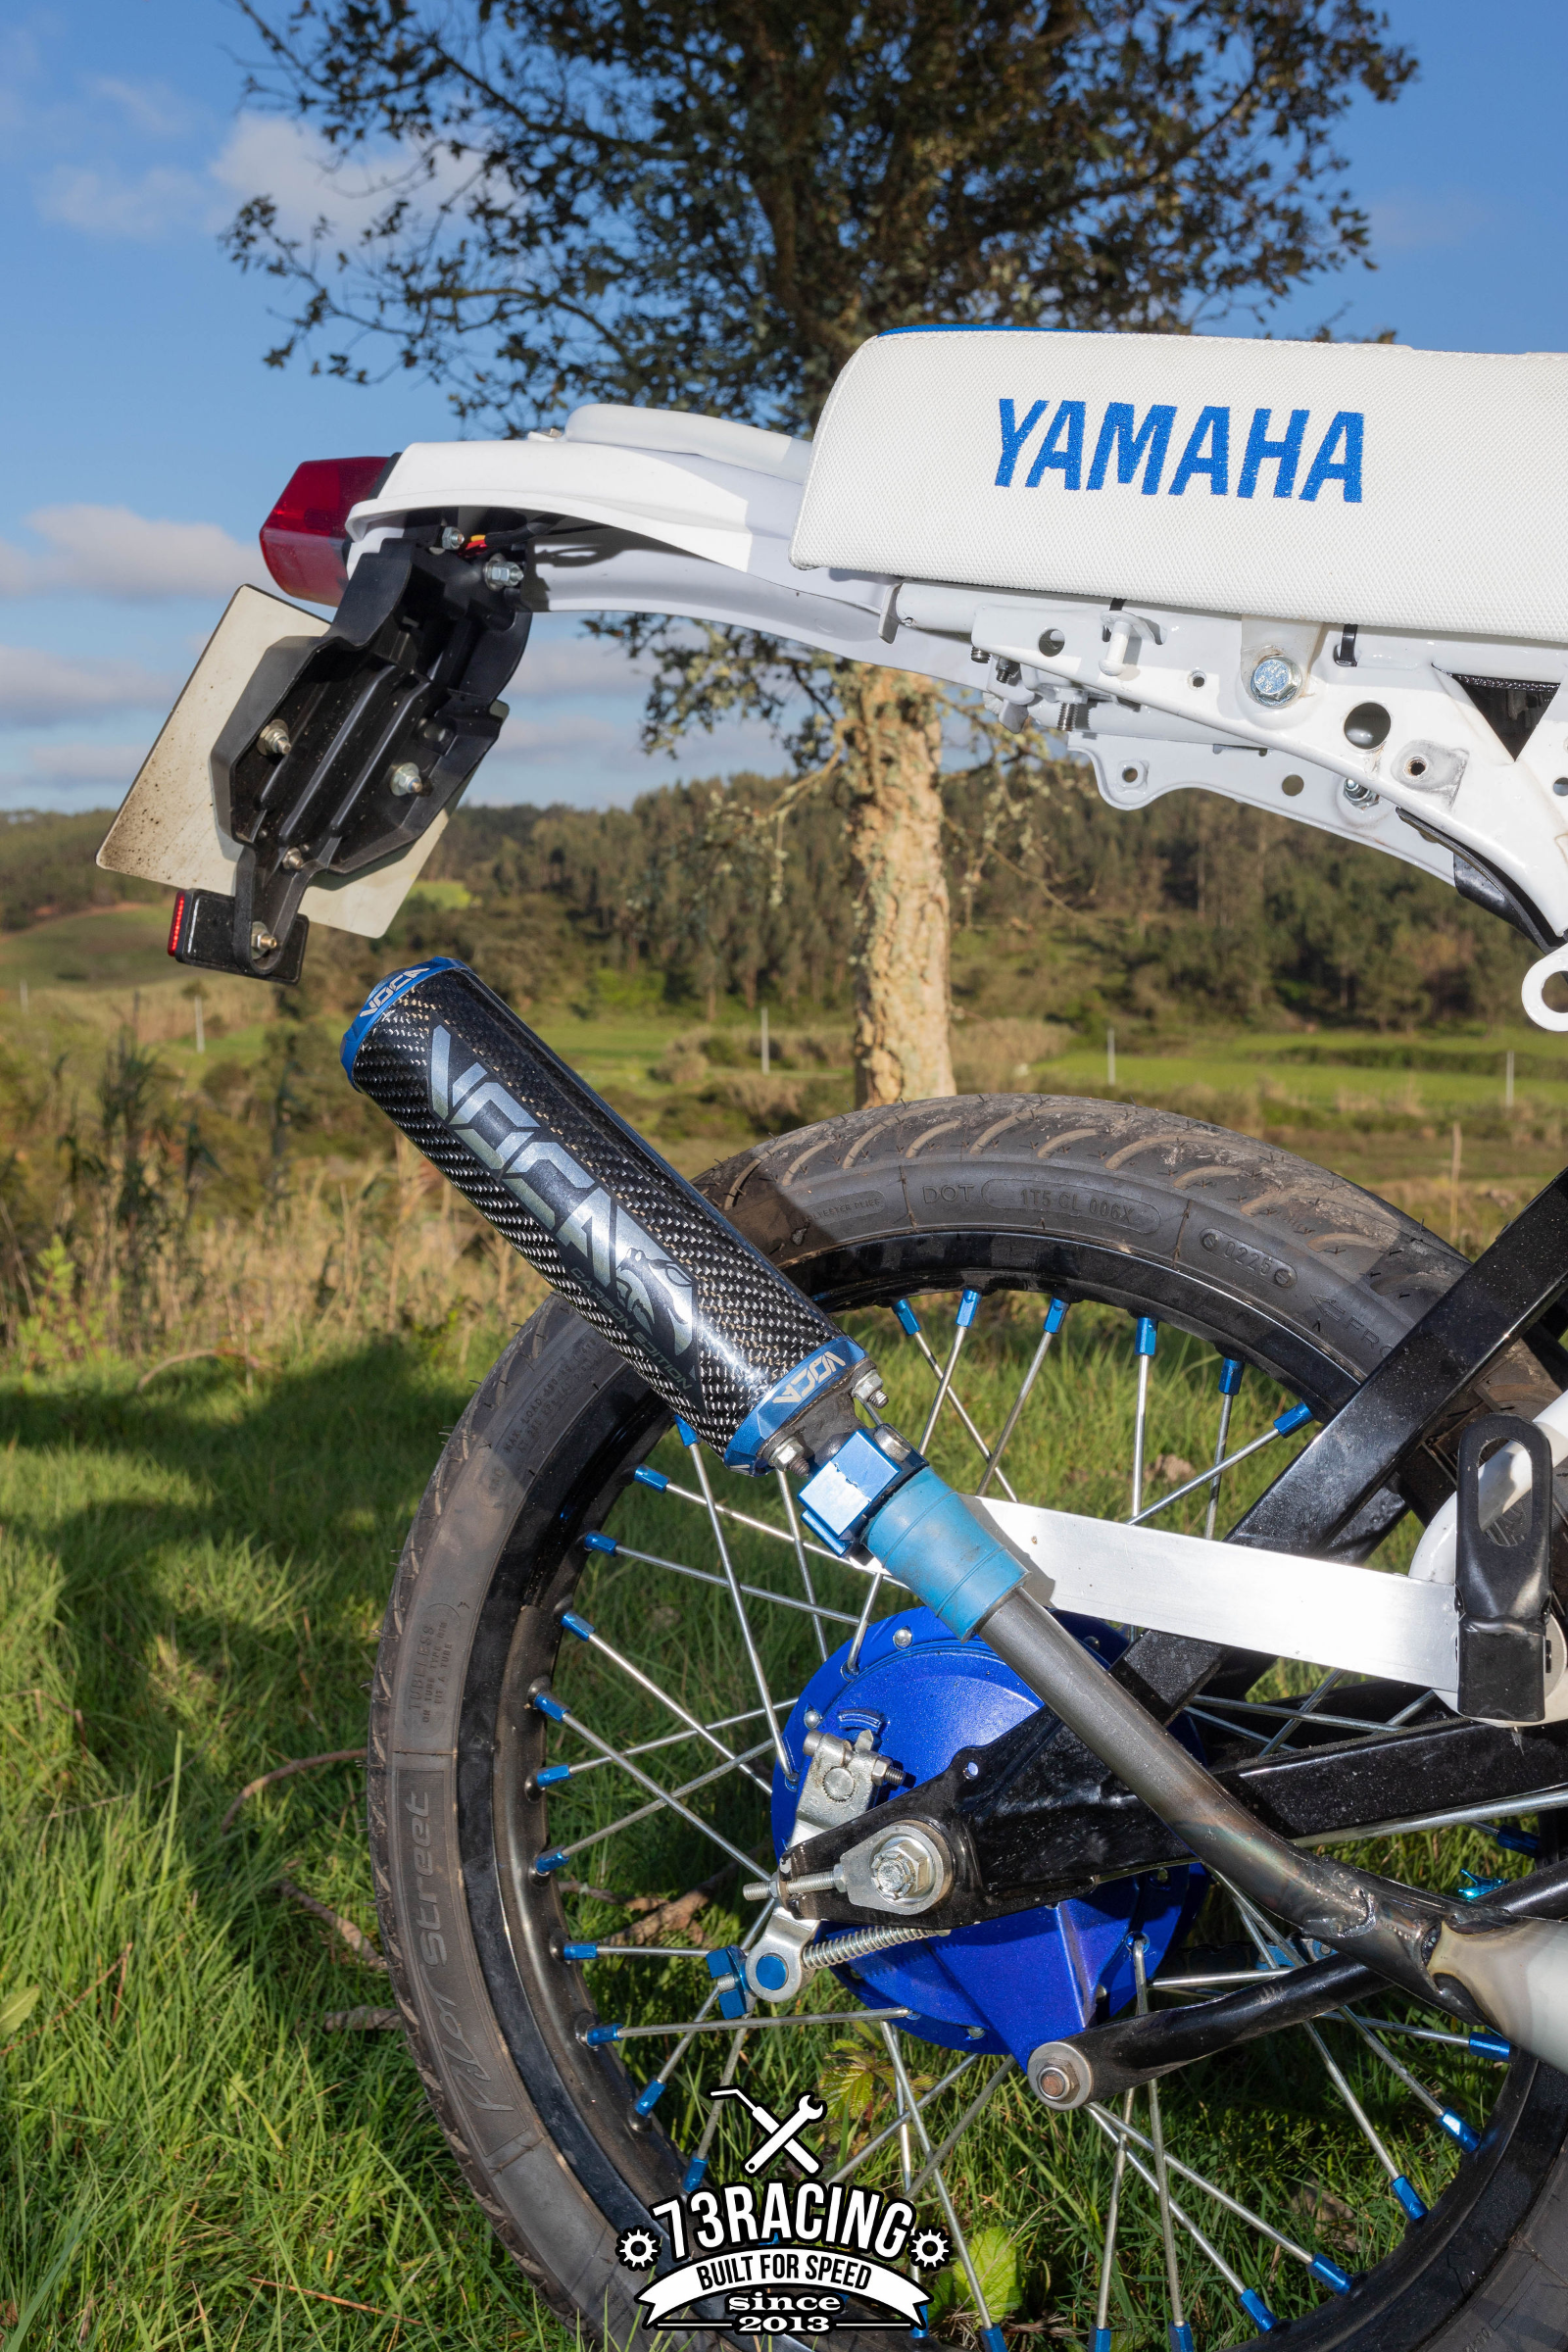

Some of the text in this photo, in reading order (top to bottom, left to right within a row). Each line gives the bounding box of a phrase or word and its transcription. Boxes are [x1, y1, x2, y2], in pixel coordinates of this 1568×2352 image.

[994, 398, 1365, 504] YAMAHA
[360, 968, 430, 1017] VOCA
[431, 1025, 611, 1288] VOCA
[923, 1184, 974, 1203] DOT
[1057, 1192, 1083, 1212] CL
[1221, 1240, 1273, 1276] 0225
[569, 1266, 692, 1391] CARBON EDITION
[772, 1351, 846, 1404] VOCA
[408, 1625, 434, 1708] TUBELESS
